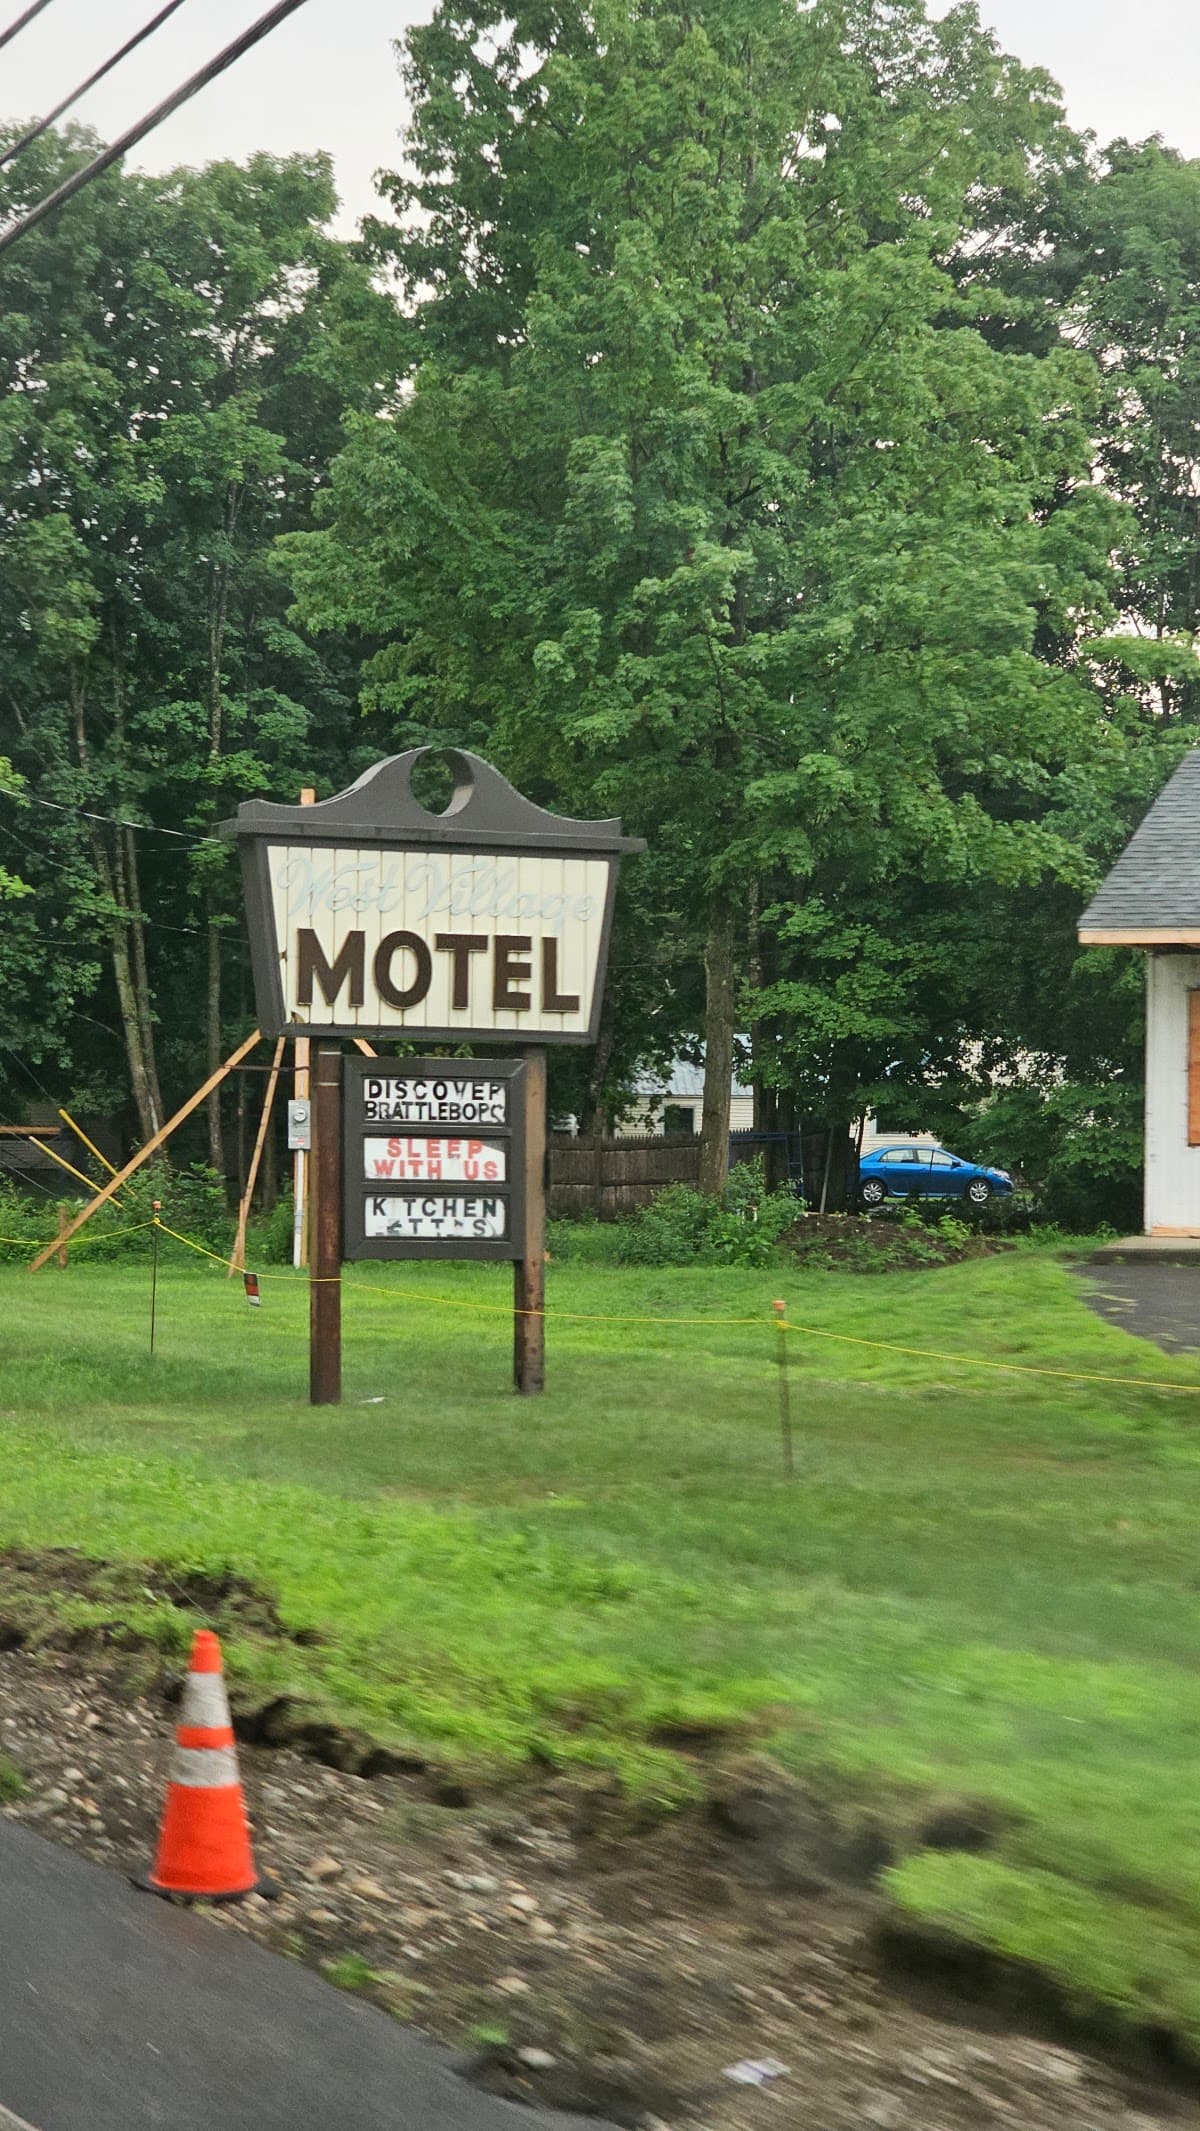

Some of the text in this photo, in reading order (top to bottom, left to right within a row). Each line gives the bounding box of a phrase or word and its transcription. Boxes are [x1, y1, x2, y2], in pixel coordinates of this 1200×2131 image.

[277, 859, 596, 930] West Village
[296, 928, 580, 1014] MOTEL
[387, 1138, 482, 1159] SLEEP
[374, 1159, 498, 1180] WITH US
[373, 1198, 497, 1218] KTCHEN
